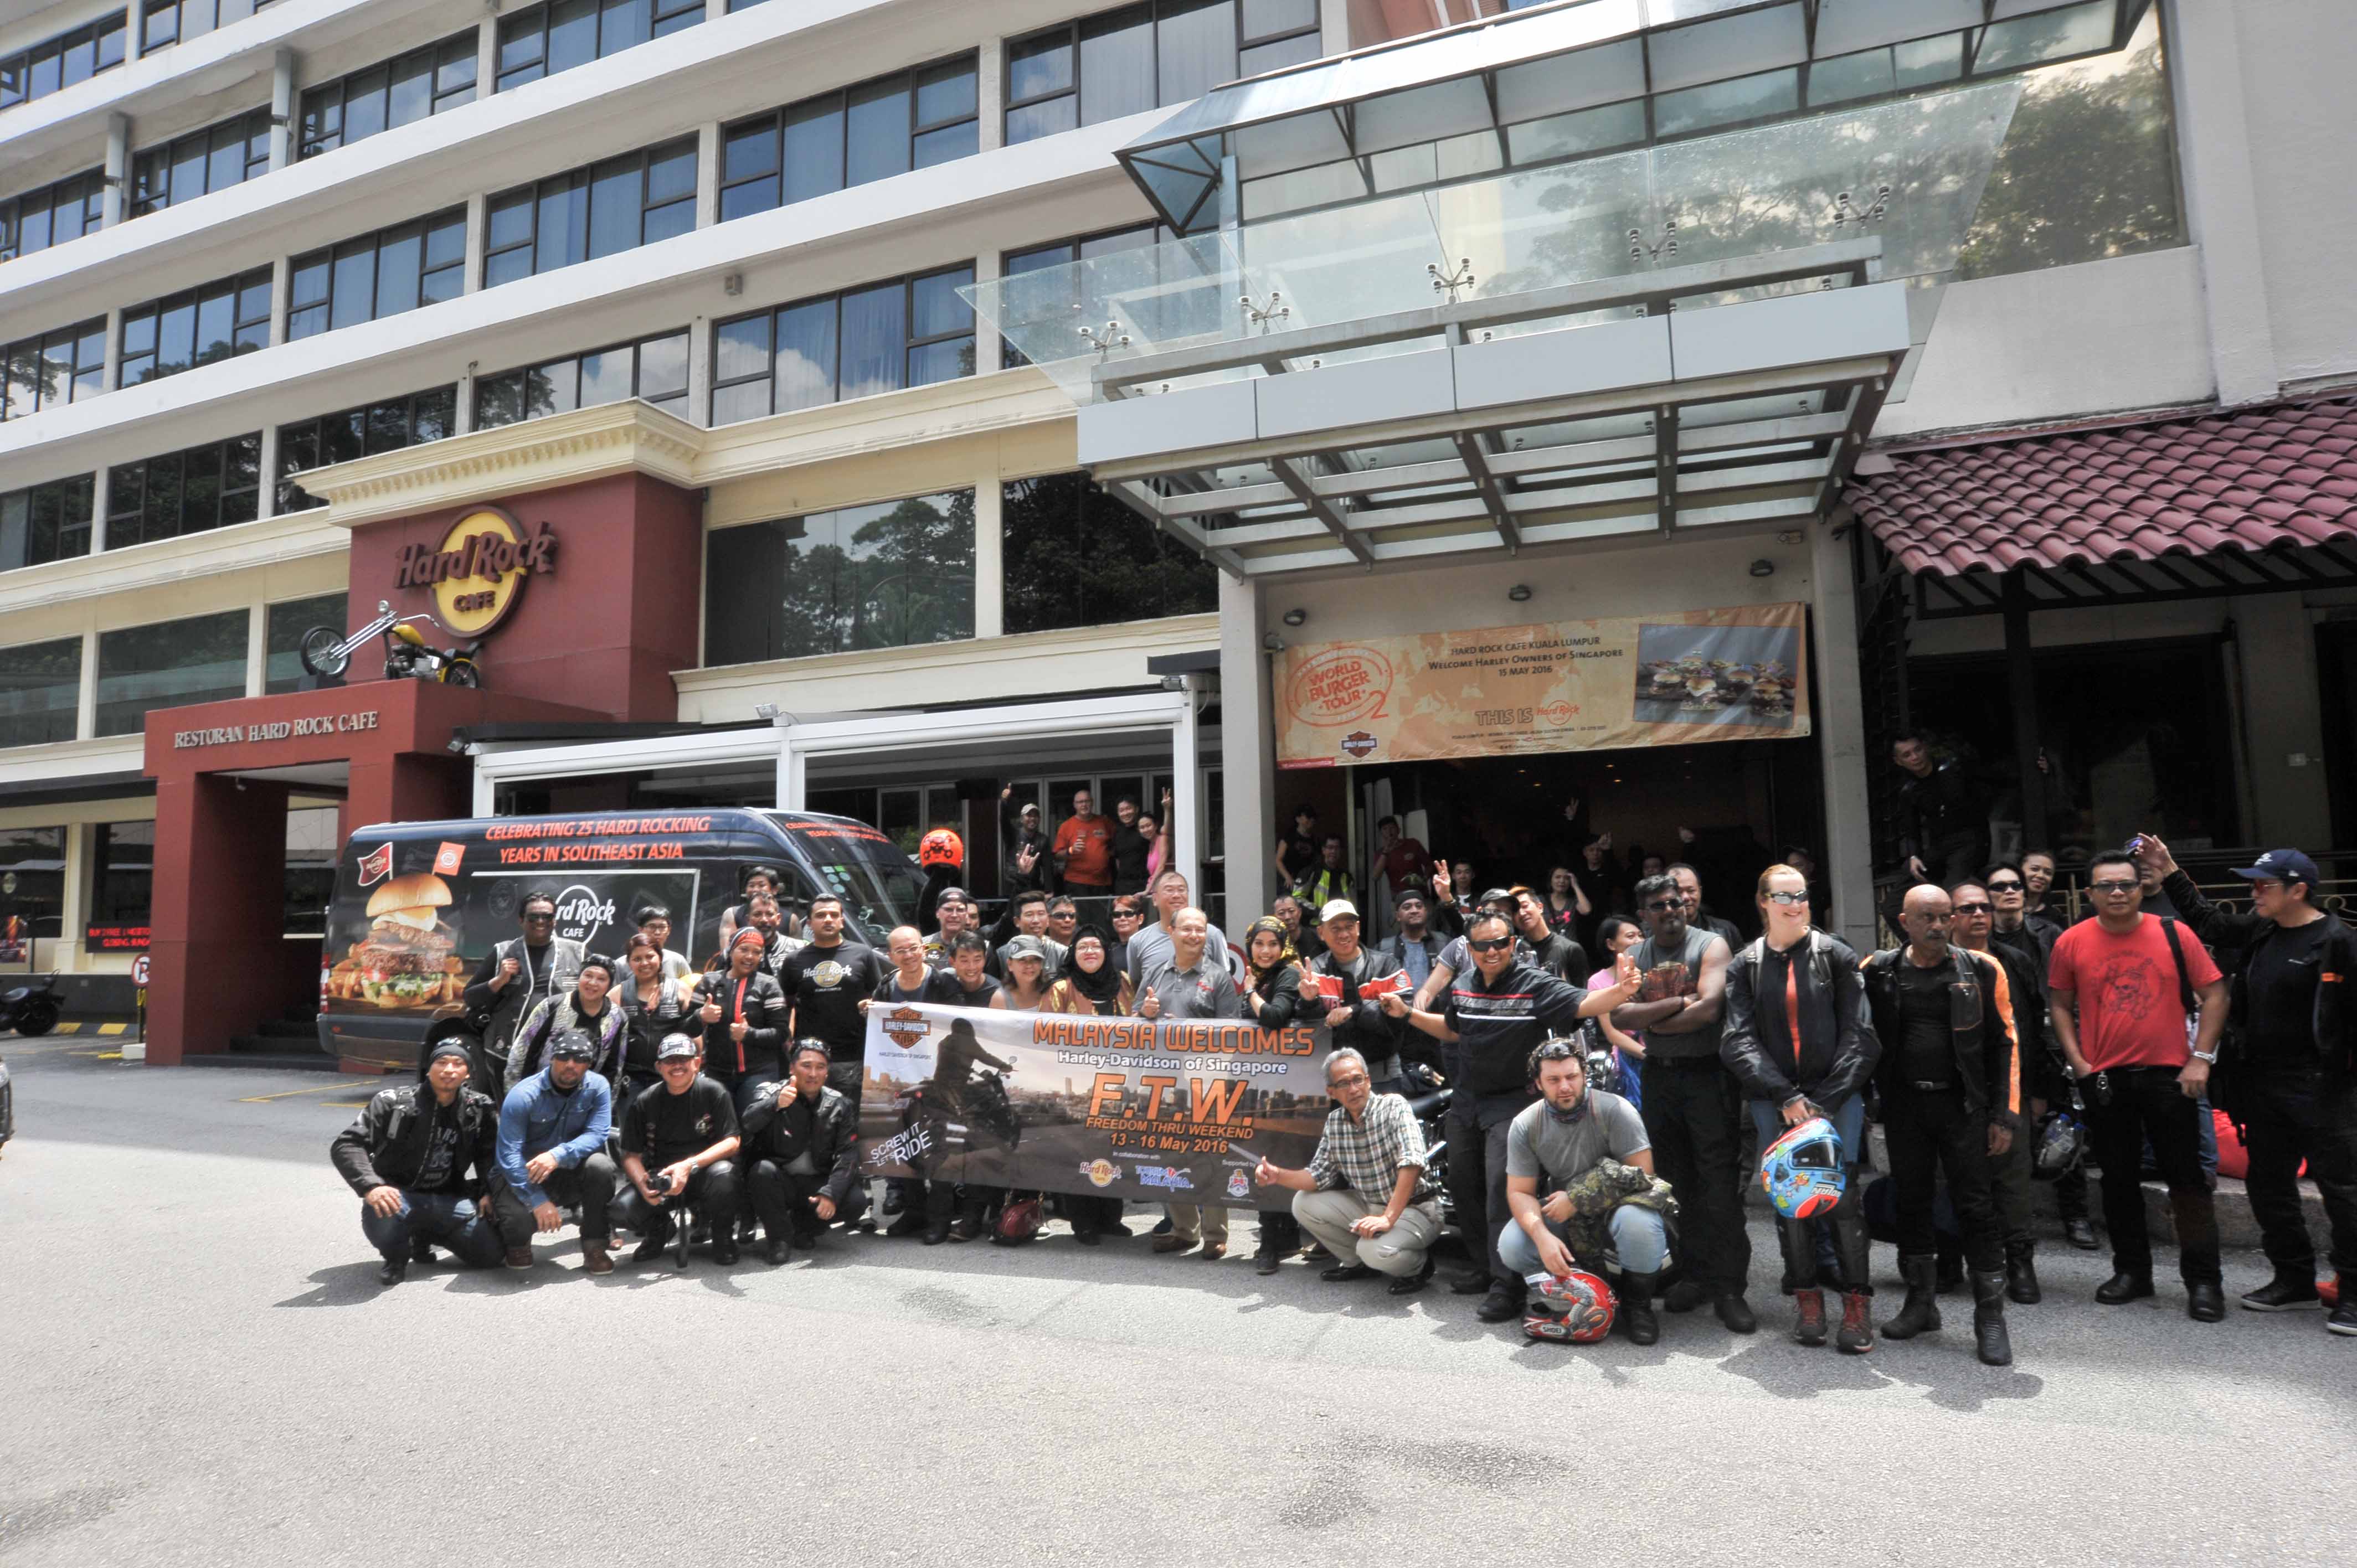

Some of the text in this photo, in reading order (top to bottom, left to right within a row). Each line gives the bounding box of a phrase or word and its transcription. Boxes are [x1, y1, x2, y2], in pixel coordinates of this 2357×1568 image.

[395, 521, 557, 589] Hard Rock
[453, 590, 496, 612] CAFE
[1451, 637, 1601, 656] HARD ROCK CAFE KUALA LUMPUR
[1309, 661, 1362, 685] WORLD
[1499, 666, 1553, 677] 15 MAY 2016
[1310, 670, 1371, 702] BURGER
[1323, 690, 1362, 710] TOUR
[1369, 689, 1389, 720] 2
[1475, 704, 1580, 726] THIS IS Hard Rock
[174, 711, 378, 749] RESTORAN HARD ROCK CAFE
[485, 816, 711, 840] CELEBRATING 25 HARD ROCKING
[501, 843, 683, 864] YEARS IN SOUTHEAST ASIA
[555, 899, 616, 925] rd Rock
[563, 927, 584, 937] CAFE
[802, 964, 852, 978] Hard Rock
[1033, 1018, 1315, 1056] MALAYSIA WELCOMES
[1058, 1051, 1288, 1076] Harley-Davidson of Singapore
[1089, 1072, 1253, 1127] F.T.W.
[1086, 1117, 1254, 1139] FREEDOM THRU WEEKEND
[871, 1122, 919, 1160] SCREW IT
[894, 1130, 933, 1165] RIDE
[1110, 1132, 1126, 1146] 13
[1140, 1135, 1156, 1148] 16
[1159, 1136, 1189, 1153] May
[1193, 1138, 1228, 1153] 2016
[1080, 1162, 1101, 1174] Hard
[1140, 1174, 1191, 1192] MALAYSIA
